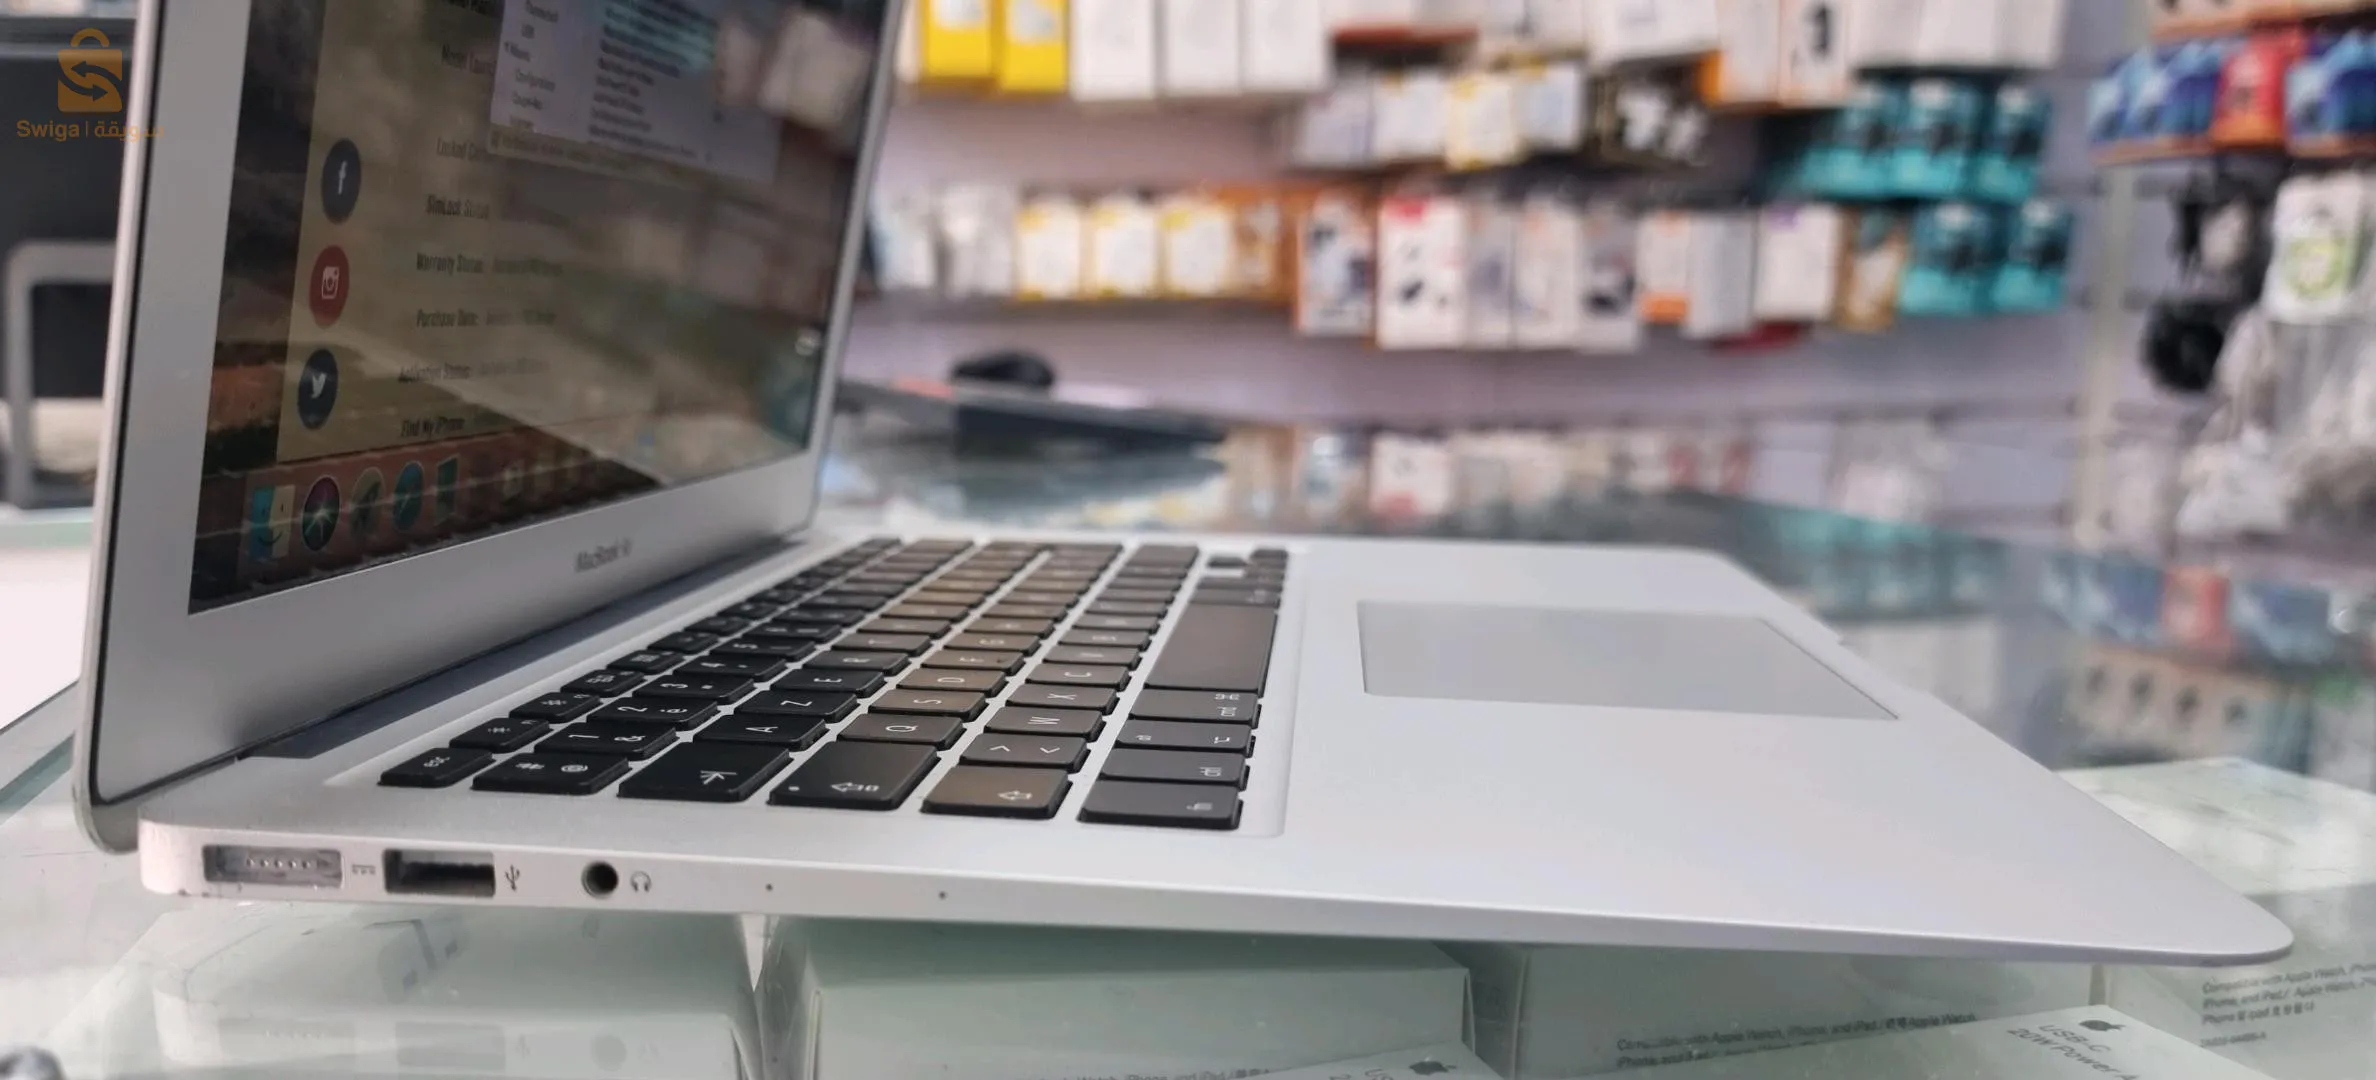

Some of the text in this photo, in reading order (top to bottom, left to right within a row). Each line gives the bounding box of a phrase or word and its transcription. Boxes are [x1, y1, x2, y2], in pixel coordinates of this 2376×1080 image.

[1028, 716, 1060, 725] W
[745, 726, 778, 734] A
[885, 725, 918, 733] Q
[2039, 1023, 2112, 1054] USB-C
[2007, 1027, 2058, 1046] 20W
[2052, 1044, 2122, 1074] Power
